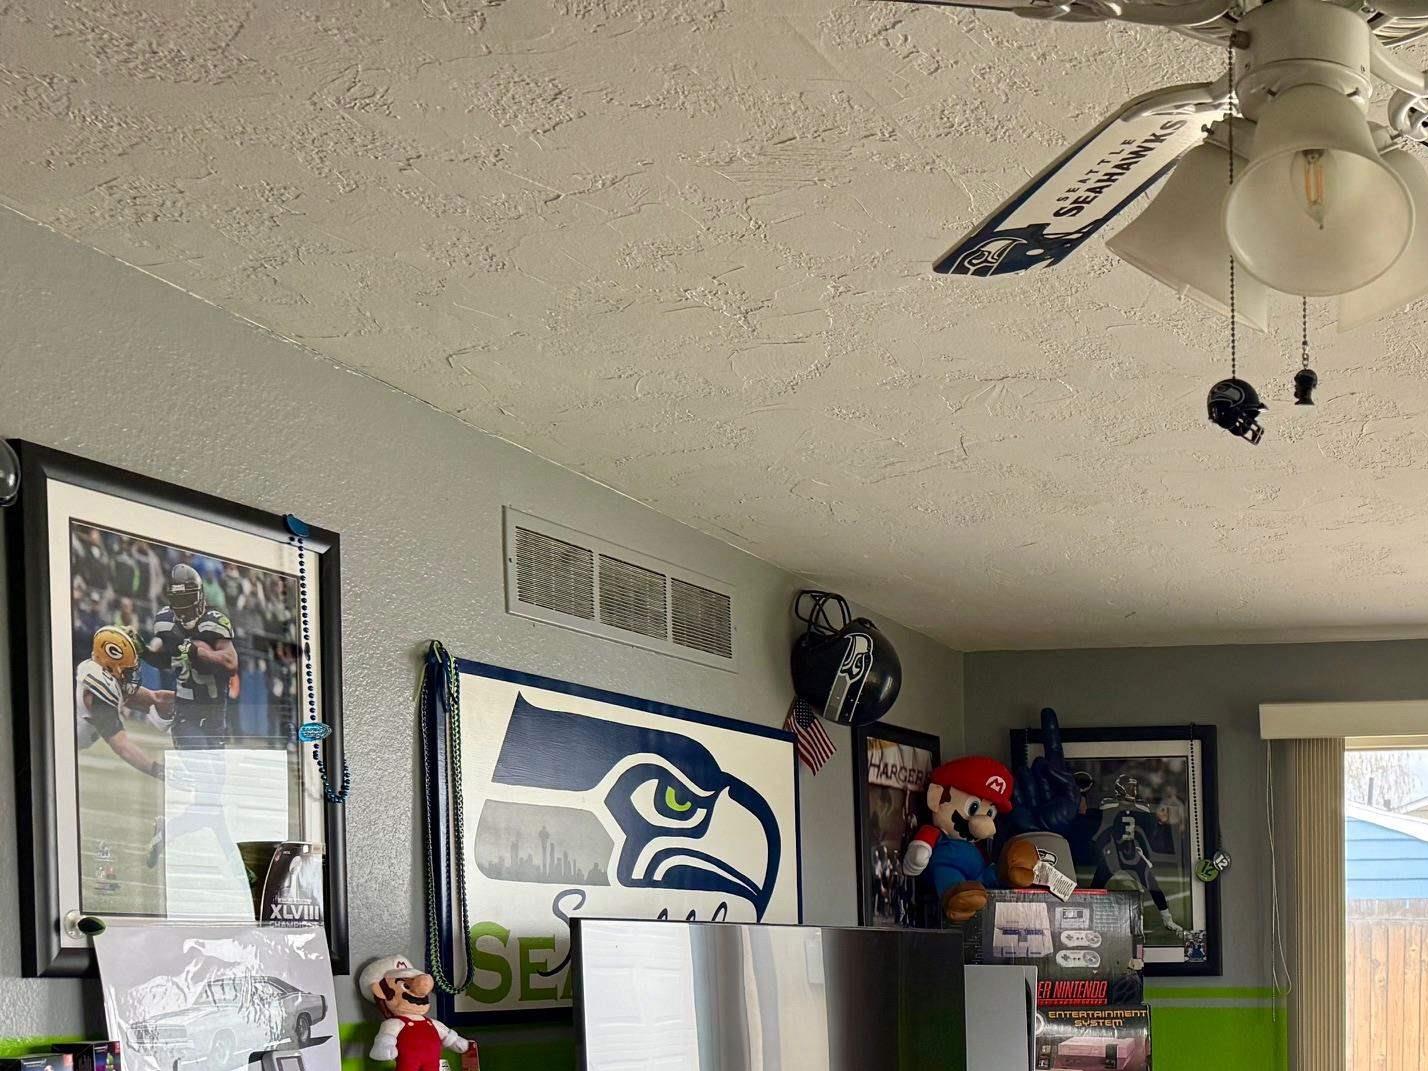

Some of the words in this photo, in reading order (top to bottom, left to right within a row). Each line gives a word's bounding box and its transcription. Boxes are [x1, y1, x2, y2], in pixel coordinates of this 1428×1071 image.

[1053, 119, 1188, 217] SEAHAWKS
[1057, 139, 1136, 202] SEATTLE
[1121, 816, 1136, 841] 3
[270, 903, 320, 920] XLVIII
[466, 921, 572, 1004] SE
[1053, 980, 1108, 999] NINTENDO
[1048, 1010, 1147, 1019] ENTERTAINMENT
[1074, 1019, 1124, 1027] SYSTEM
